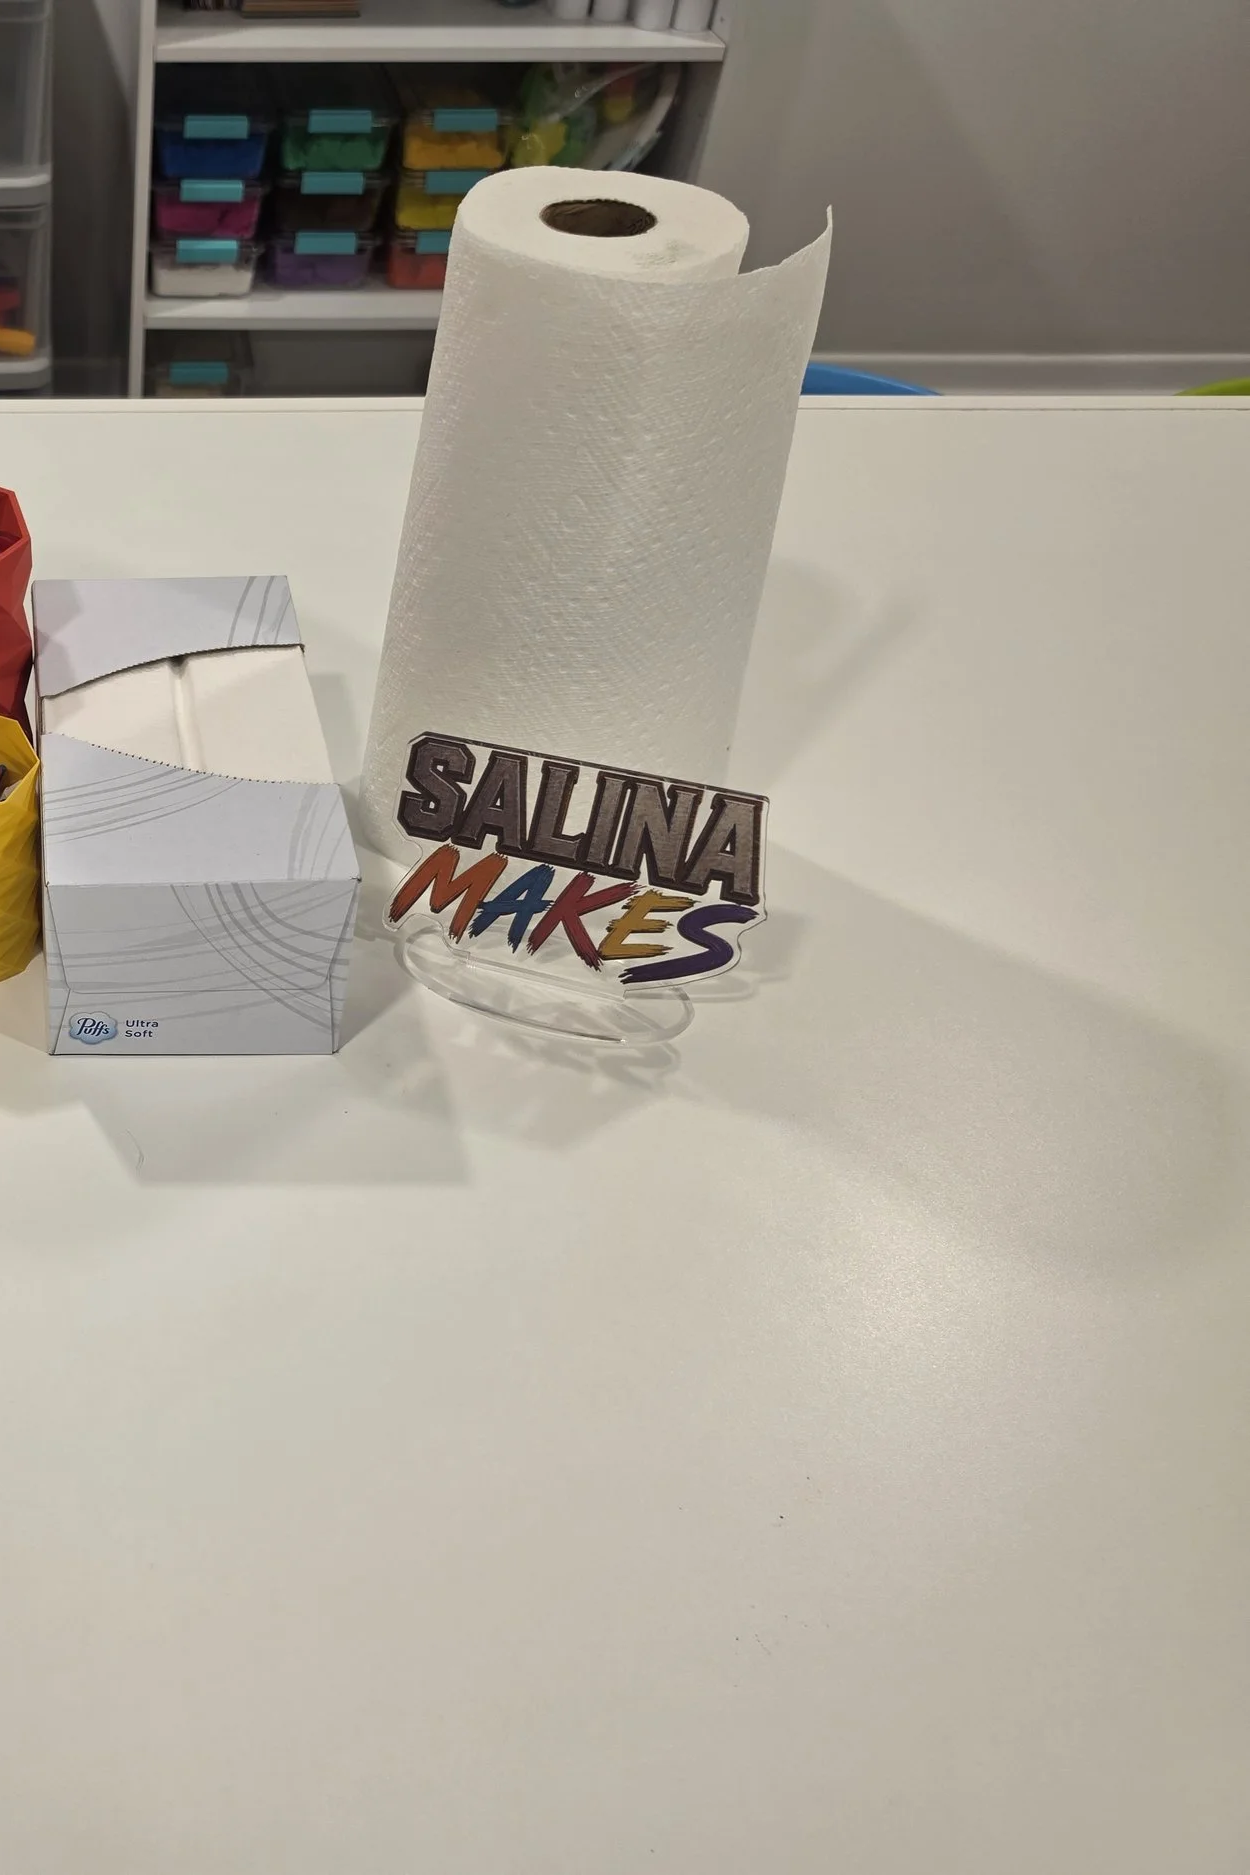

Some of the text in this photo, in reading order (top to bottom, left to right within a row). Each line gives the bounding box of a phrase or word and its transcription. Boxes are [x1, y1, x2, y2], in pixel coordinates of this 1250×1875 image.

[397, 736, 764, 906] SALINA
[389, 843, 760, 985] MAKES
[76, 1017, 110, 1037] Puffs
[125, 1019, 159, 1028] Ultra
[125, 1029, 153, 1038] Soft
